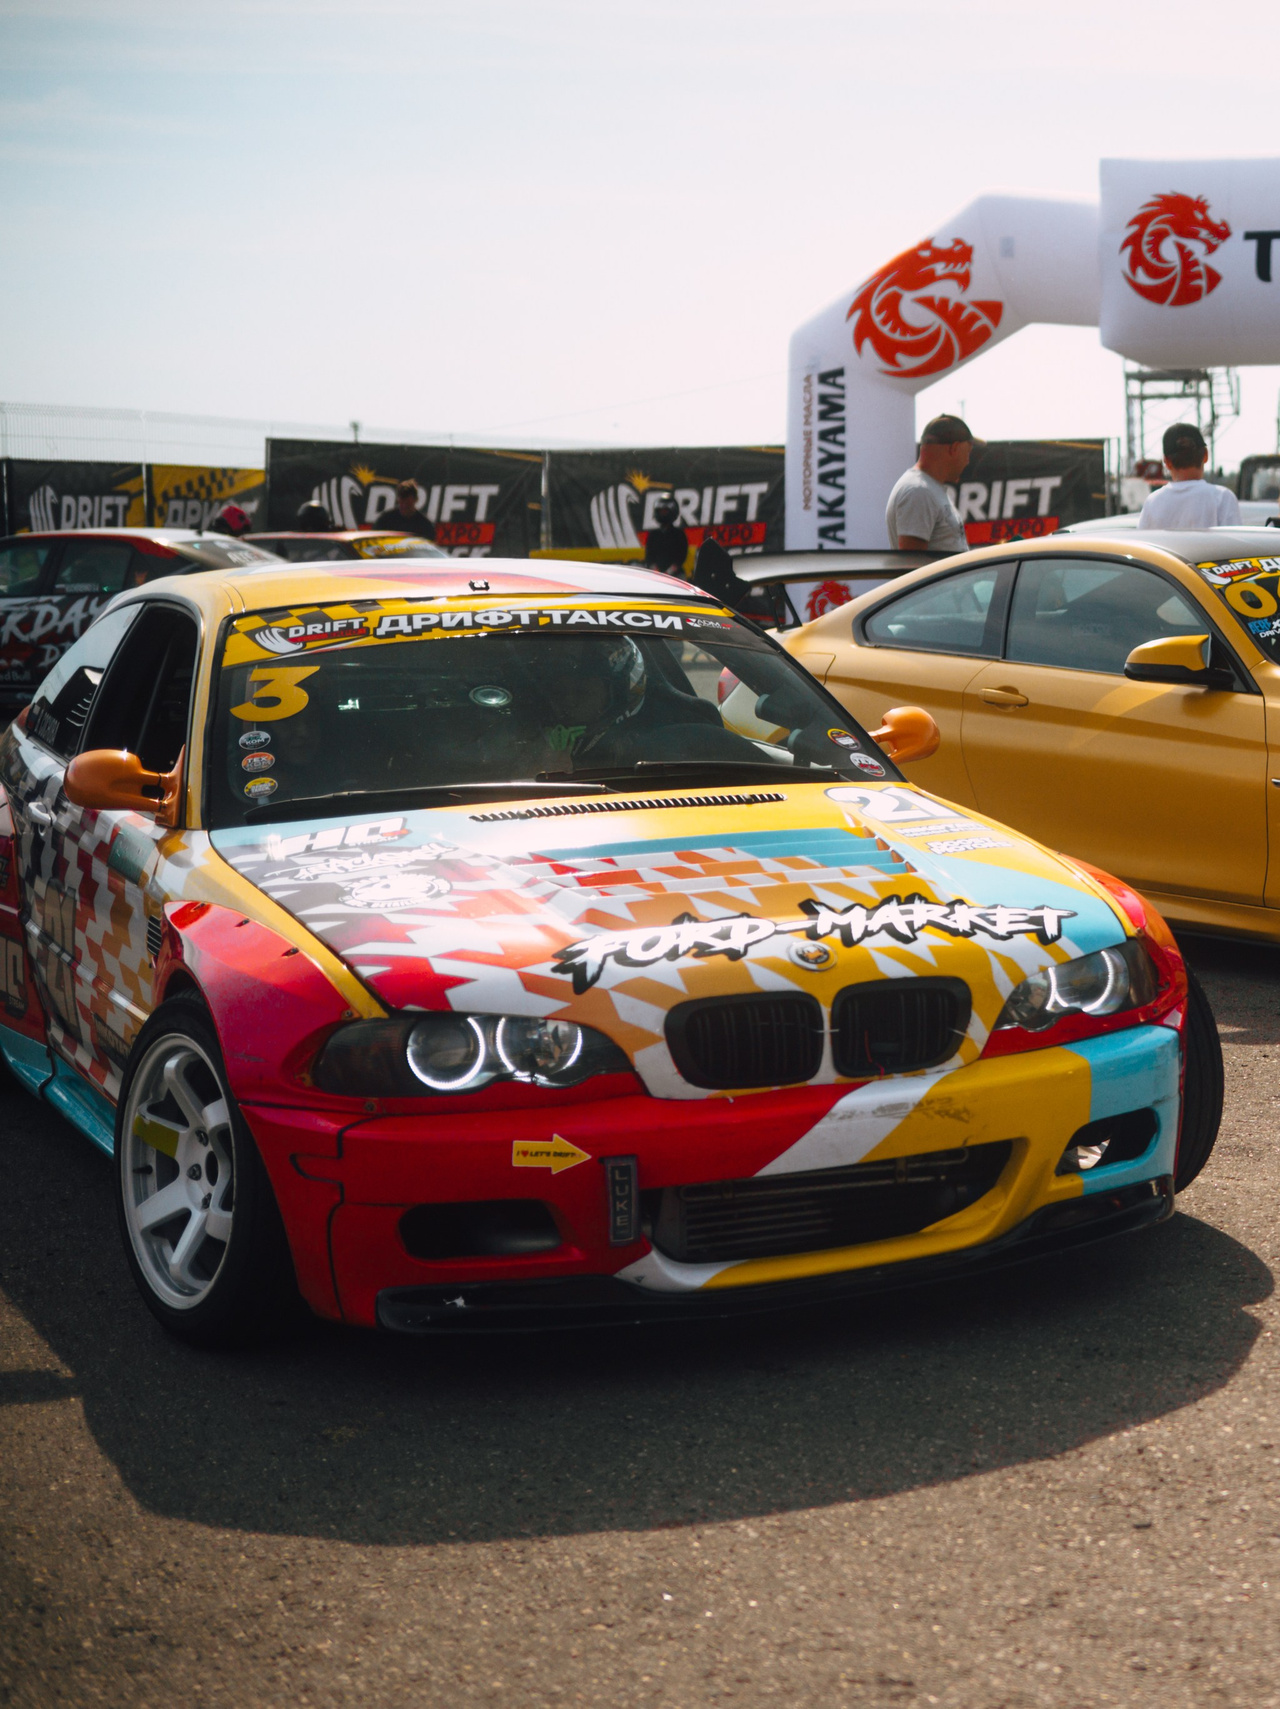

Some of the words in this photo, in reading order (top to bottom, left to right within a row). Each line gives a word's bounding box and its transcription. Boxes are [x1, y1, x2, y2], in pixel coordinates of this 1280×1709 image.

[818, 366, 846, 550] AKAYAMA
[60, 495, 129, 529] DRIFT
[1212, 560, 1254, 575] DRIFT
[288, 617, 365, 639] DRIFT
[376, 610, 538, 637] ДРИФТ
[542, 610, 683, 631] ТАКСИ
[229, 665, 321, 722] 3
[824, 786, 966, 823] 21
